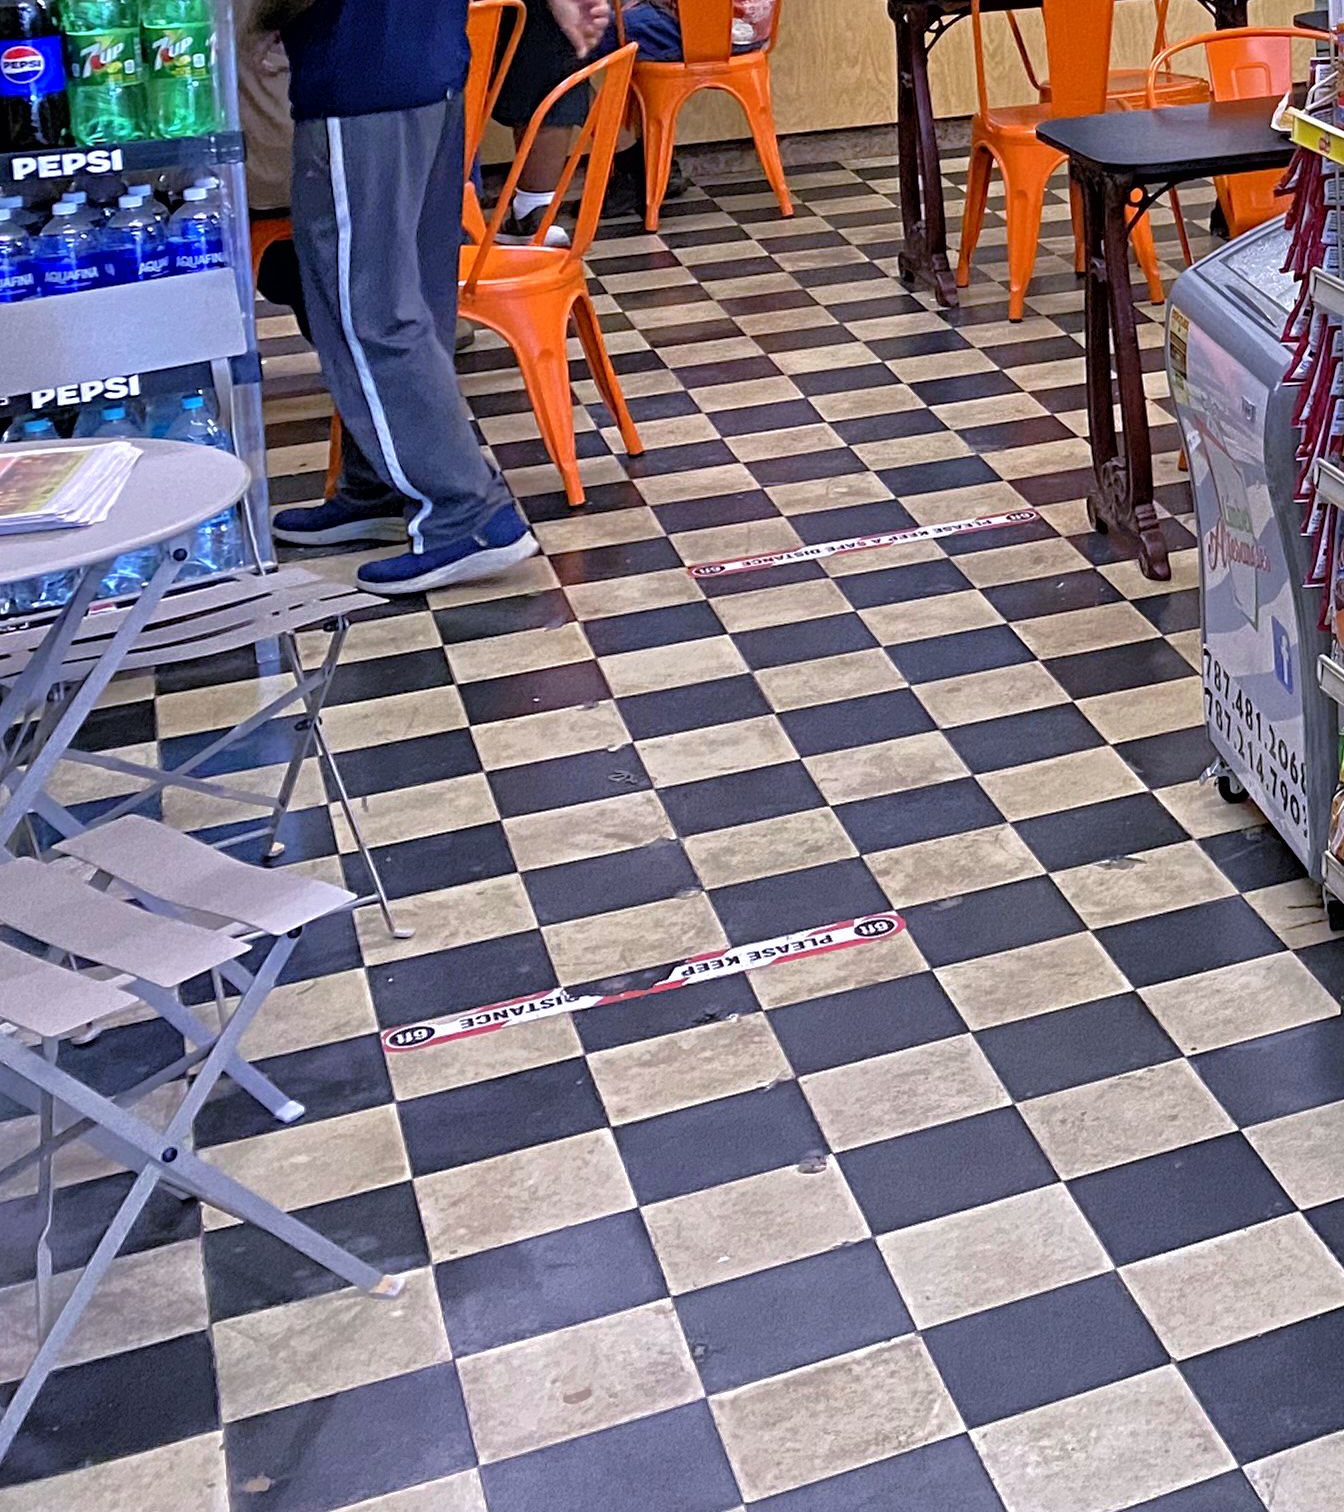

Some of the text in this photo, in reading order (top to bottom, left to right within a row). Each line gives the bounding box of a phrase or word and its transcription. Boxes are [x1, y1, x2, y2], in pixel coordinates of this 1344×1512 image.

[2, 58, 44, 71] PEPSI
[12, 149, 123, 181] PEPSI
[31, 375, 141, 409] PEPSI
[750, 933, 833, 961] PLEASE
[681, 952, 740, 977] KEEP
